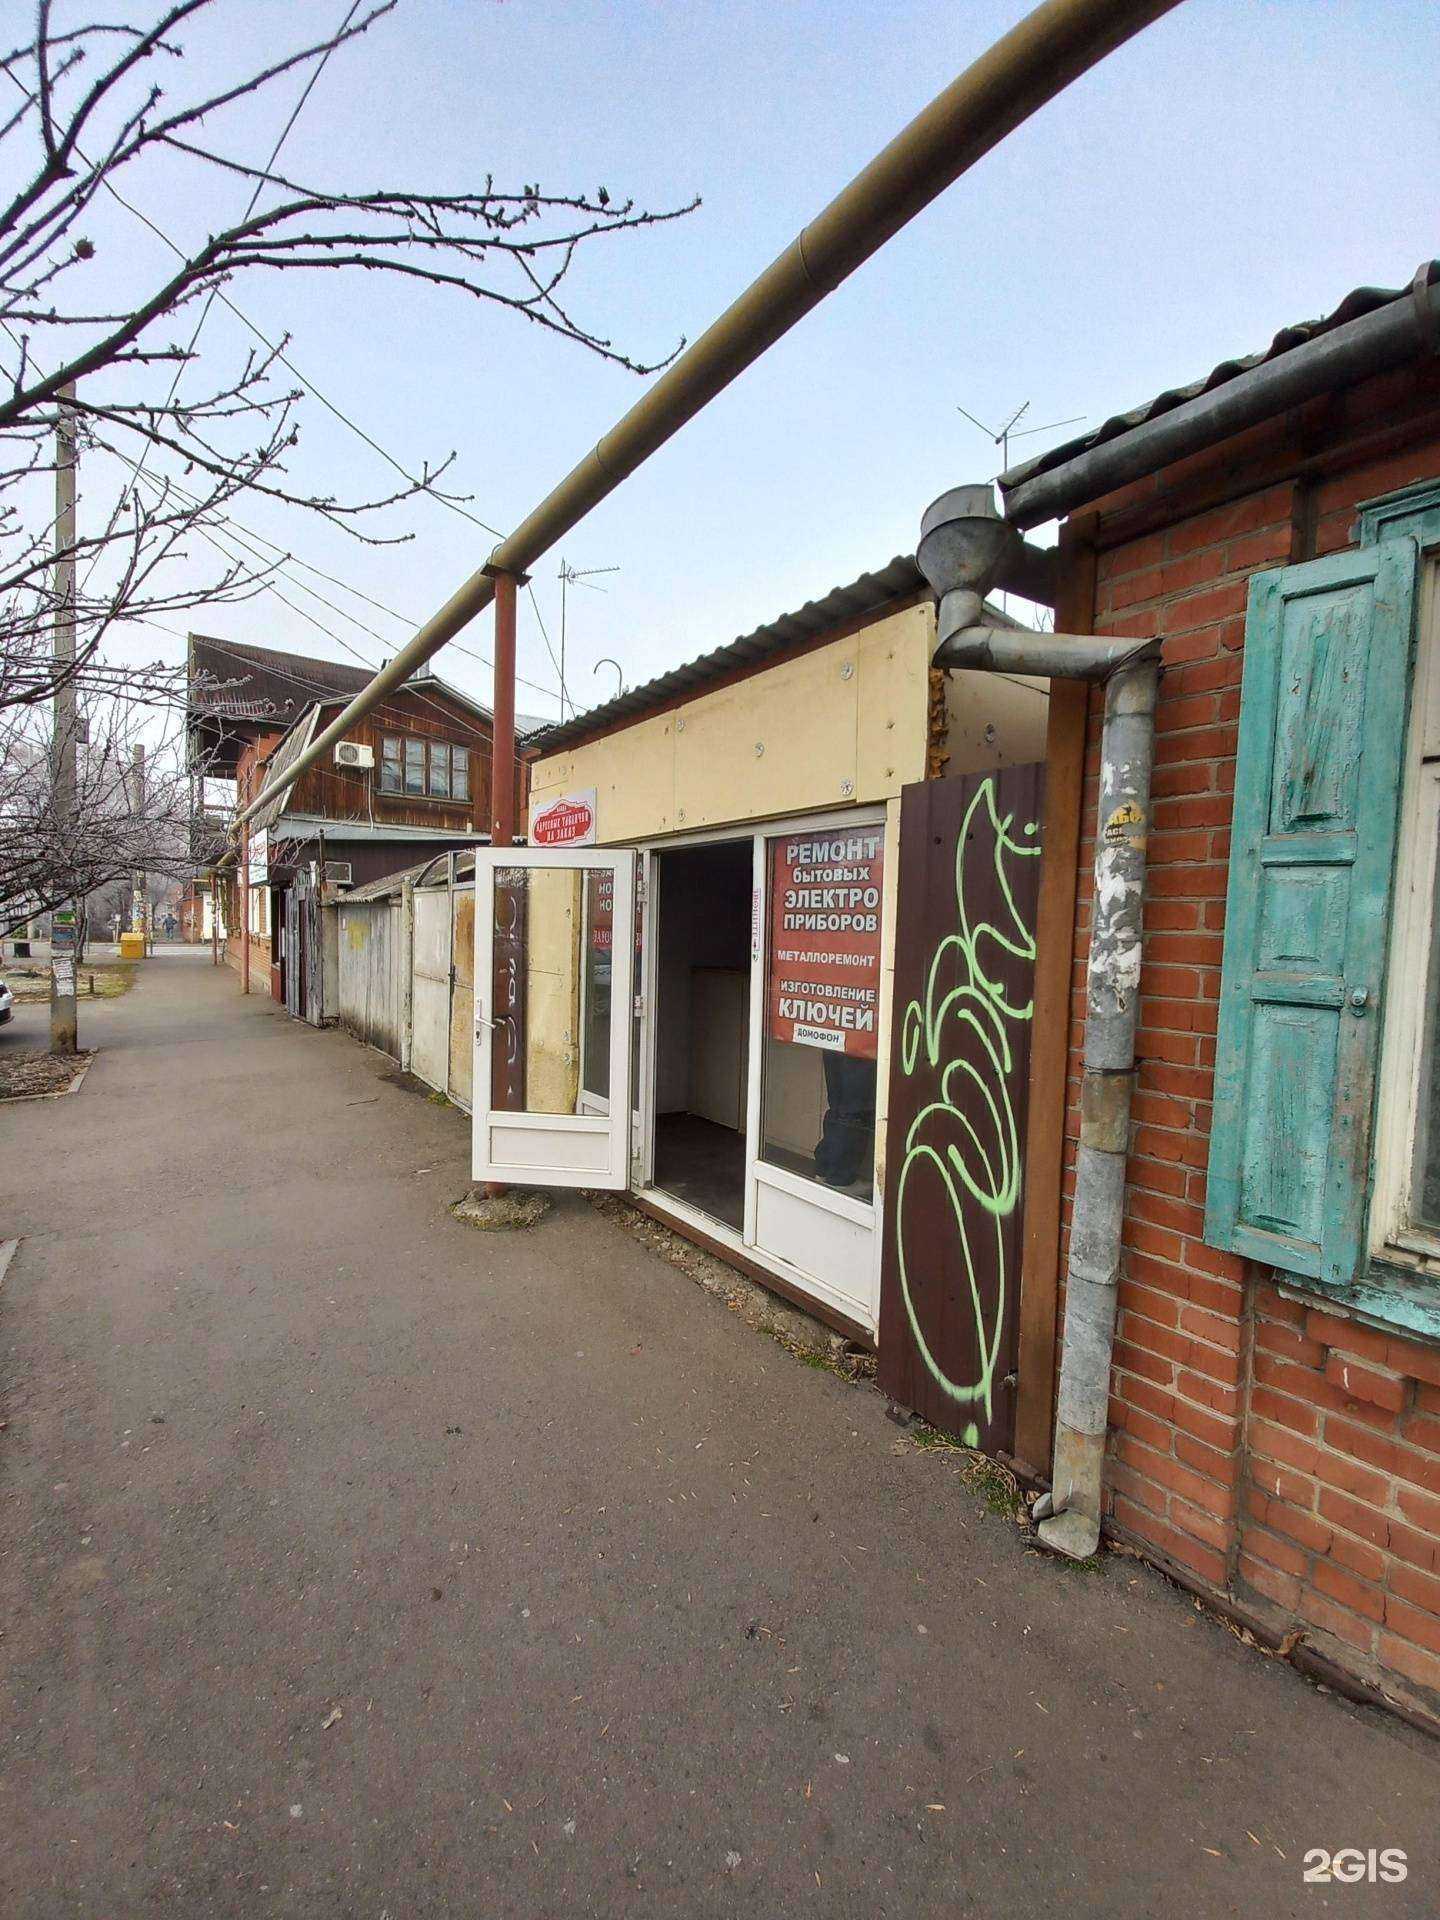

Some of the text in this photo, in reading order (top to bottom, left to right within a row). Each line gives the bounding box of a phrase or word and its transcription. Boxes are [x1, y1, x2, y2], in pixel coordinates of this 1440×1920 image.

[786, 836, 880, 865] РЕМОНТ
[793, 866, 870, 883] бытовых
[784, 887, 879, 909] ЭЛЕКТРО
[783, 913, 877, 931] ПРИБОРОВ
[777, 950, 876, 967] МЕТАЛЛОРЕМОНТ
[780, 980, 876, 1002] ИЗГОТОВЛЕНИЕ
[778, 998, 874, 1031] КЛЮЧЕЙ
[797, 1028, 840, 1043] ДОМОФОН
